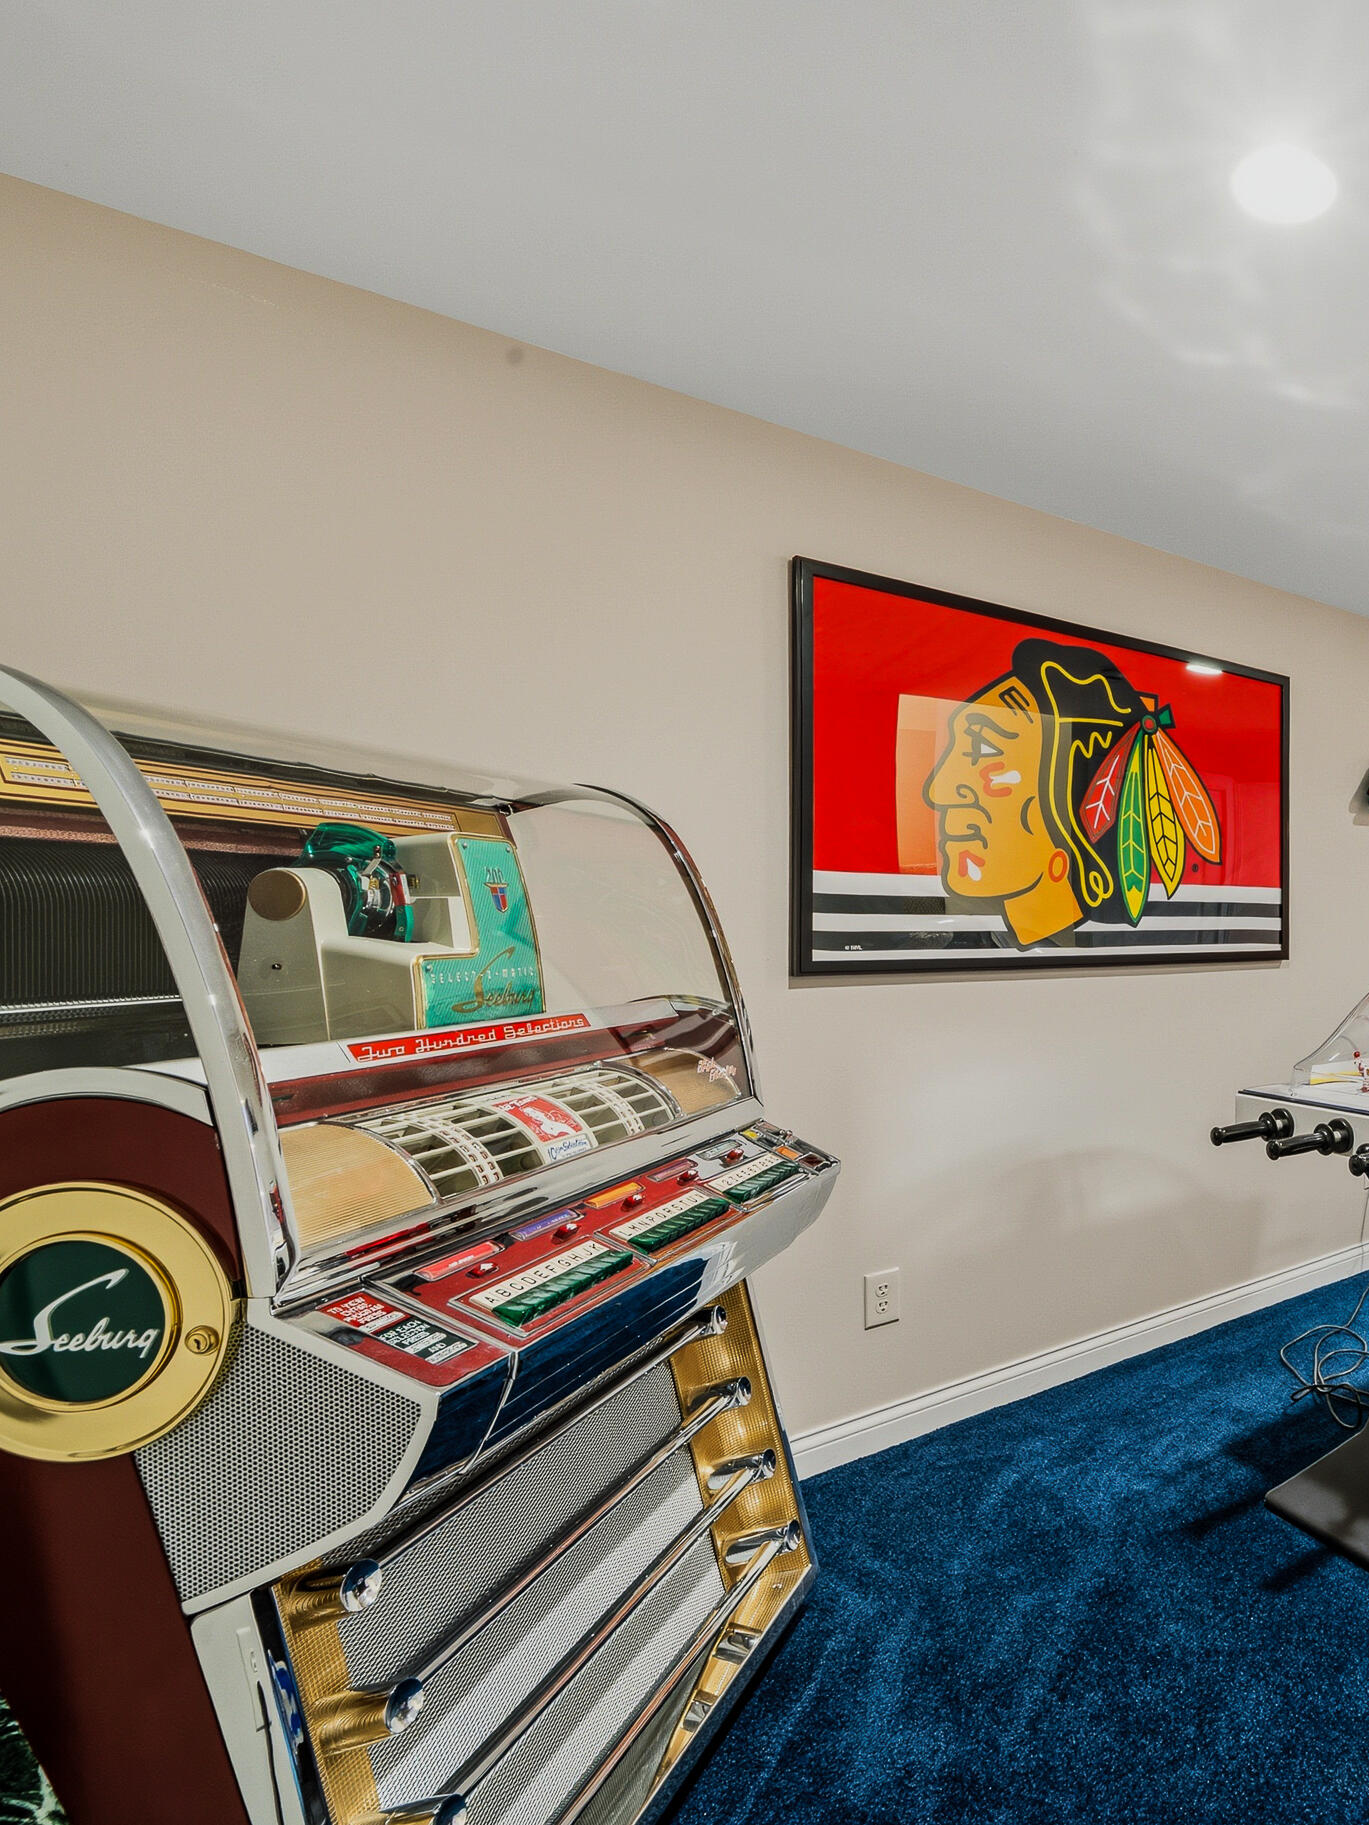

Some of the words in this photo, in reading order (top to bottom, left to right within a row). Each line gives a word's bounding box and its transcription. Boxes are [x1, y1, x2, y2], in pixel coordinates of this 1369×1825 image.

[451, 946, 535, 1013] Seeburg
[357, 1046, 405, 1062] Two
[415, 1029, 496, 1054] Hundred
[504, 1018, 584, 1040] Selections
[0, 1268, 160, 1358] Seeburg
